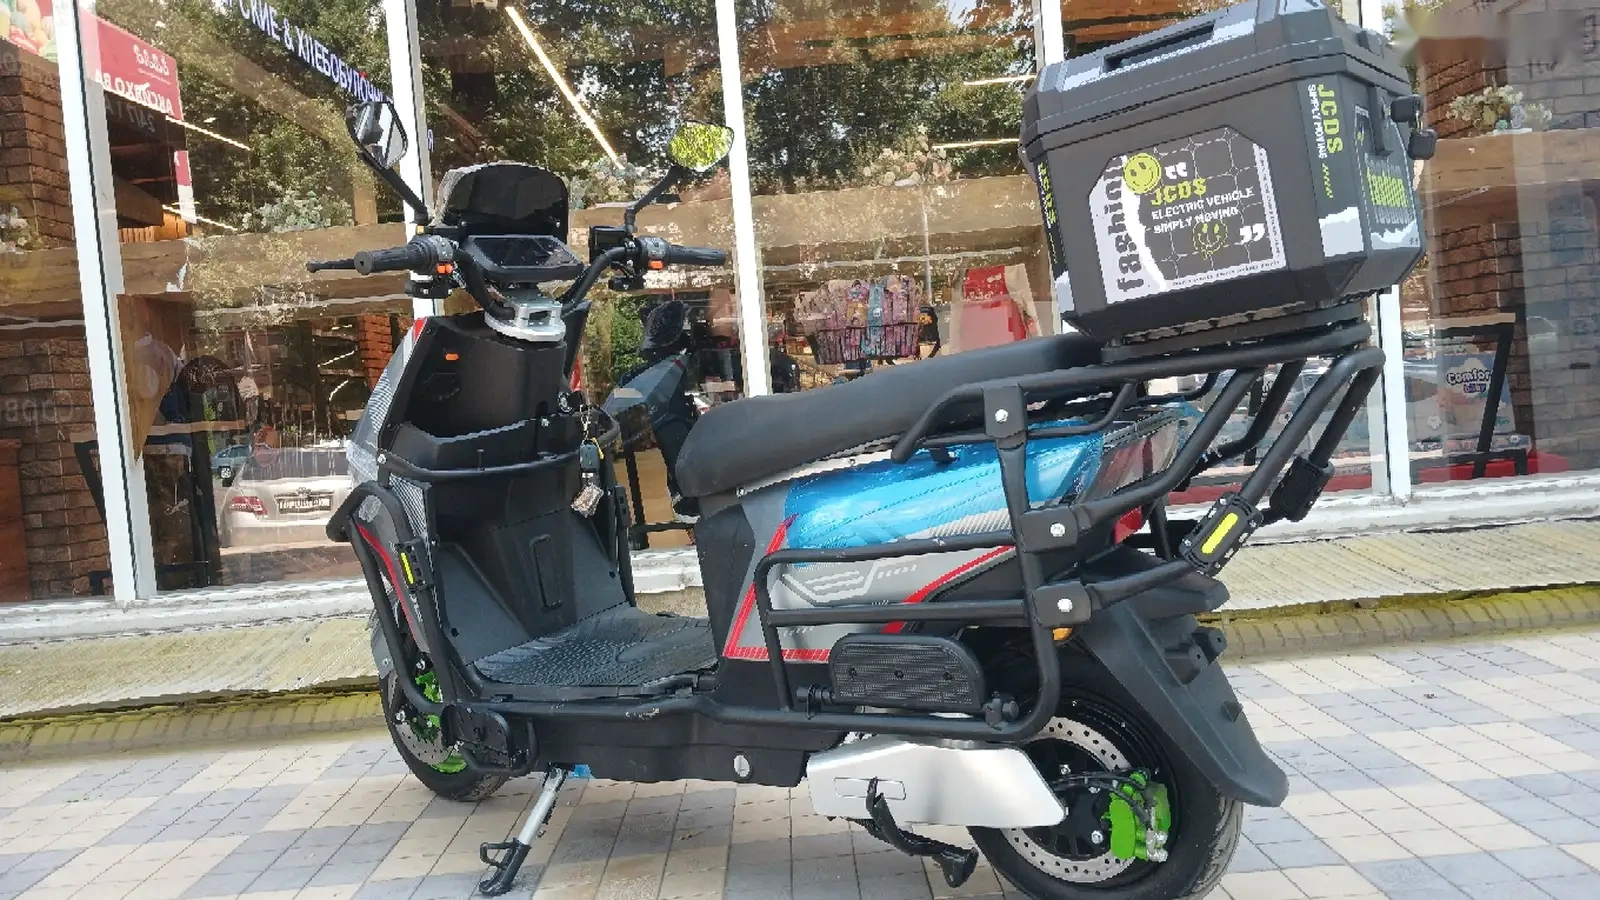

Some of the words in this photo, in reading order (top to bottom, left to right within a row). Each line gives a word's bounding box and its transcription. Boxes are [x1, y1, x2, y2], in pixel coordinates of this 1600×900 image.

[1308, 84, 1322, 120] SIMPLY
[1317, 84, 1343, 153] JCDS
[1313, 121, 1328, 159] MOVING
[1150, 177, 1207, 206] JCDS
[1151, 199, 1205, 220] ELECTRIC
[1205, 187, 1255, 207] VEHICLE
[1153, 215, 1193, 234] SIMPLY
[1194, 206, 1239, 224] MOVING
[1446, 367, 1492, 386] Comfor
